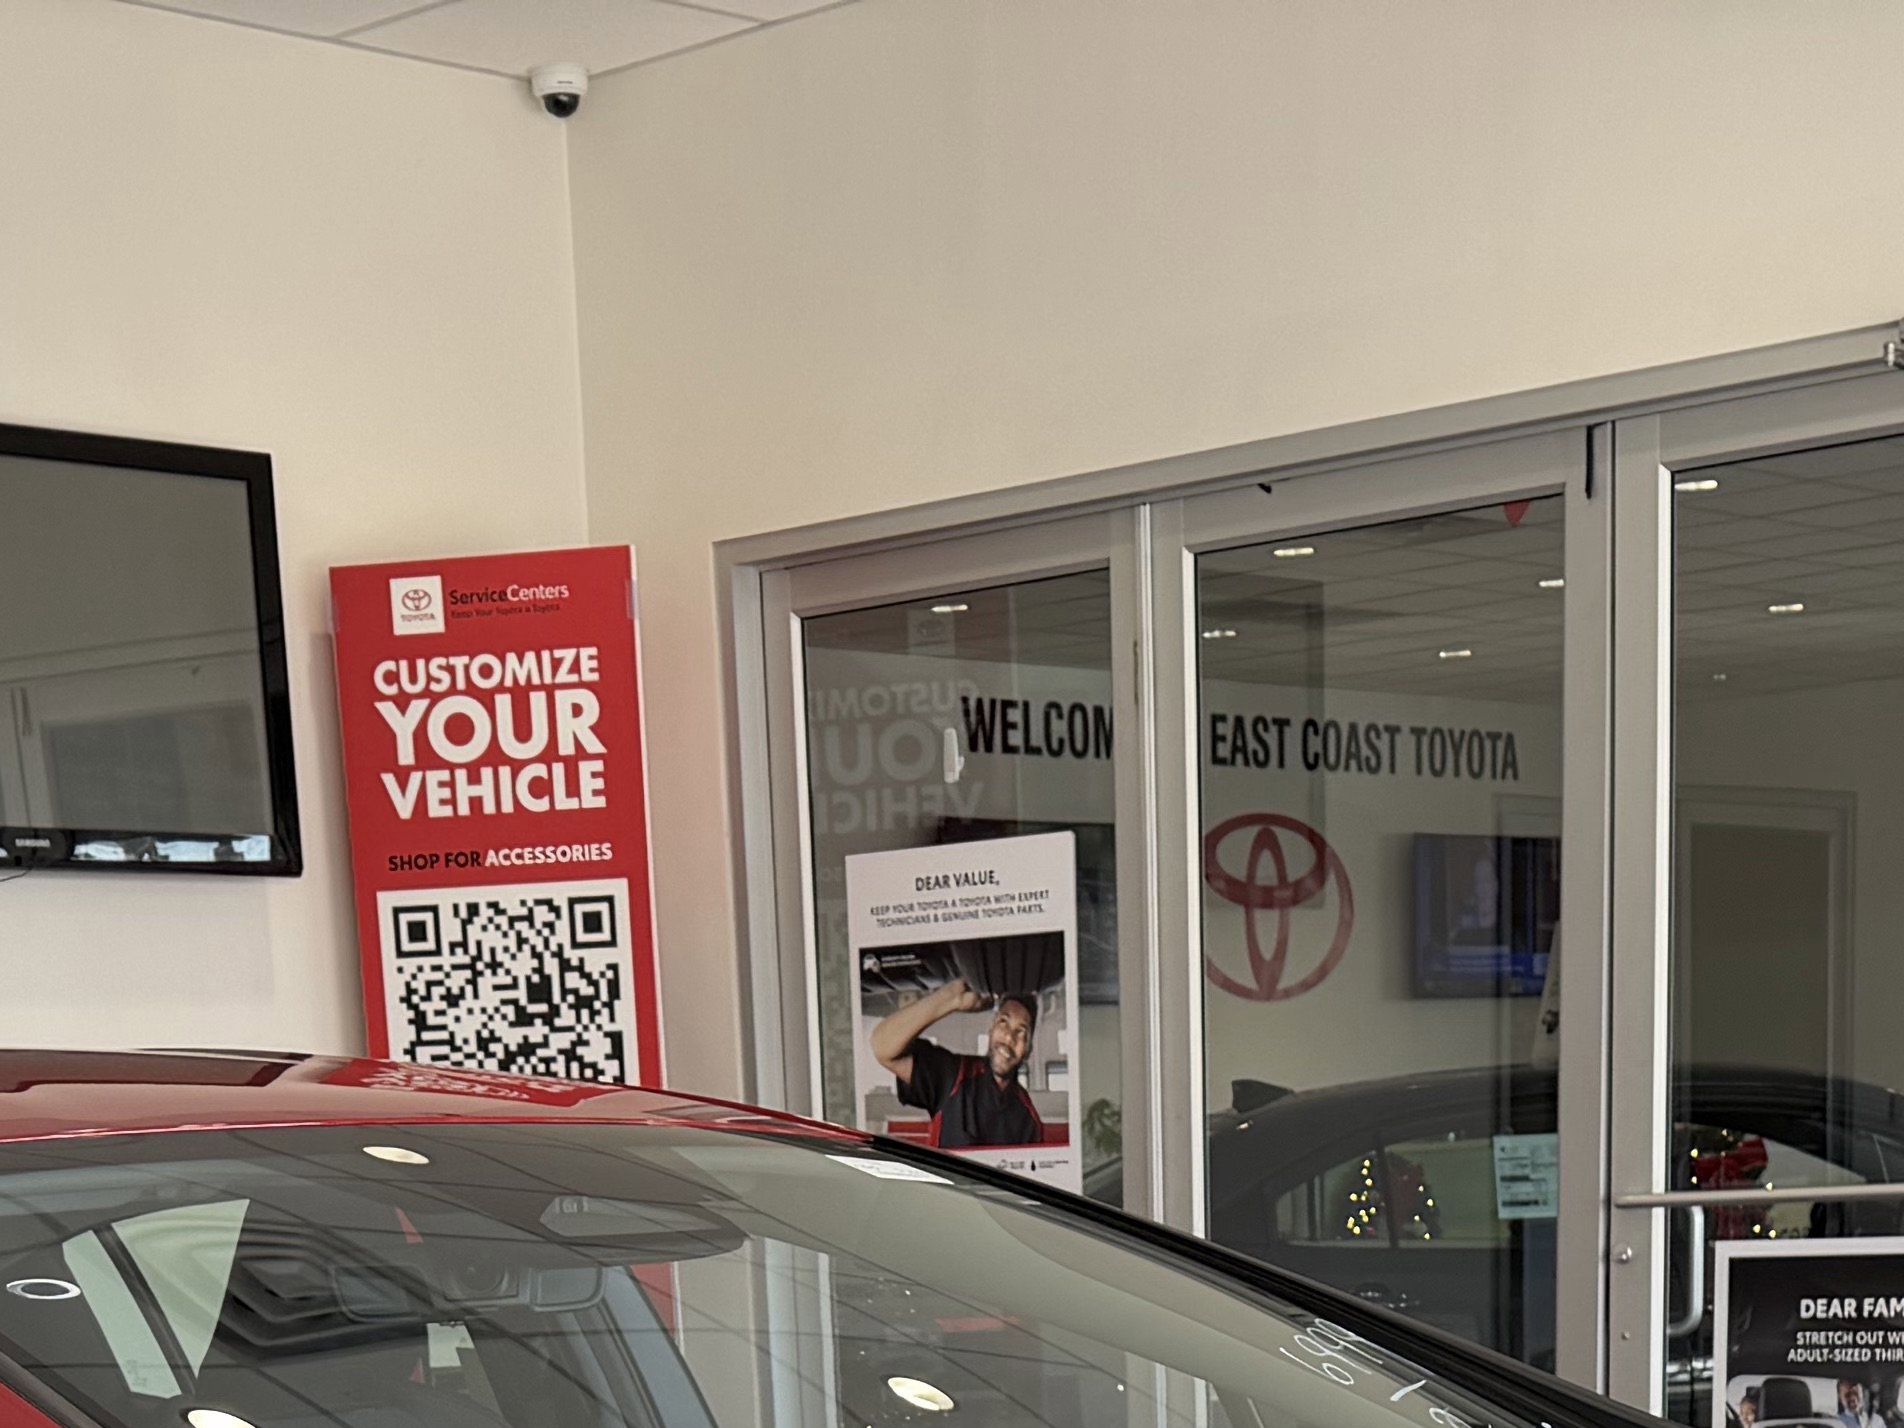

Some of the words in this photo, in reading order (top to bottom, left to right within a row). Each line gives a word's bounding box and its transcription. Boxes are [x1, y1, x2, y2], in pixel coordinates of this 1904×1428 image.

[373, 647, 600, 695] CUSTOMIZE
[375, 689, 607, 765] YOUR
[1209, 713, 1291, 769] EAST
[1302, 718, 1401, 775] COAST
[1409, 727, 1520, 782] TOYOTA
[381, 760, 606, 820] VEHICLE
[387, 852, 440, 872] SHOP
[444, 849, 482, 869] FOR
[485, 843, 613, 867] ACCESSORIES
[915, 874, 950, 891] DEAR
[953, 870, 1000, 888] VALUE,
[1018, 890, 1049, 902] EXPERT
[1799, 1298, 1857, 1319] DEAR
[1796, 1331, 1853, 1345] STRETCH
[1855, 1331, 1884, 1345] OUT
[1787, 1348, 1871, 1362] ADULT-SIZED
